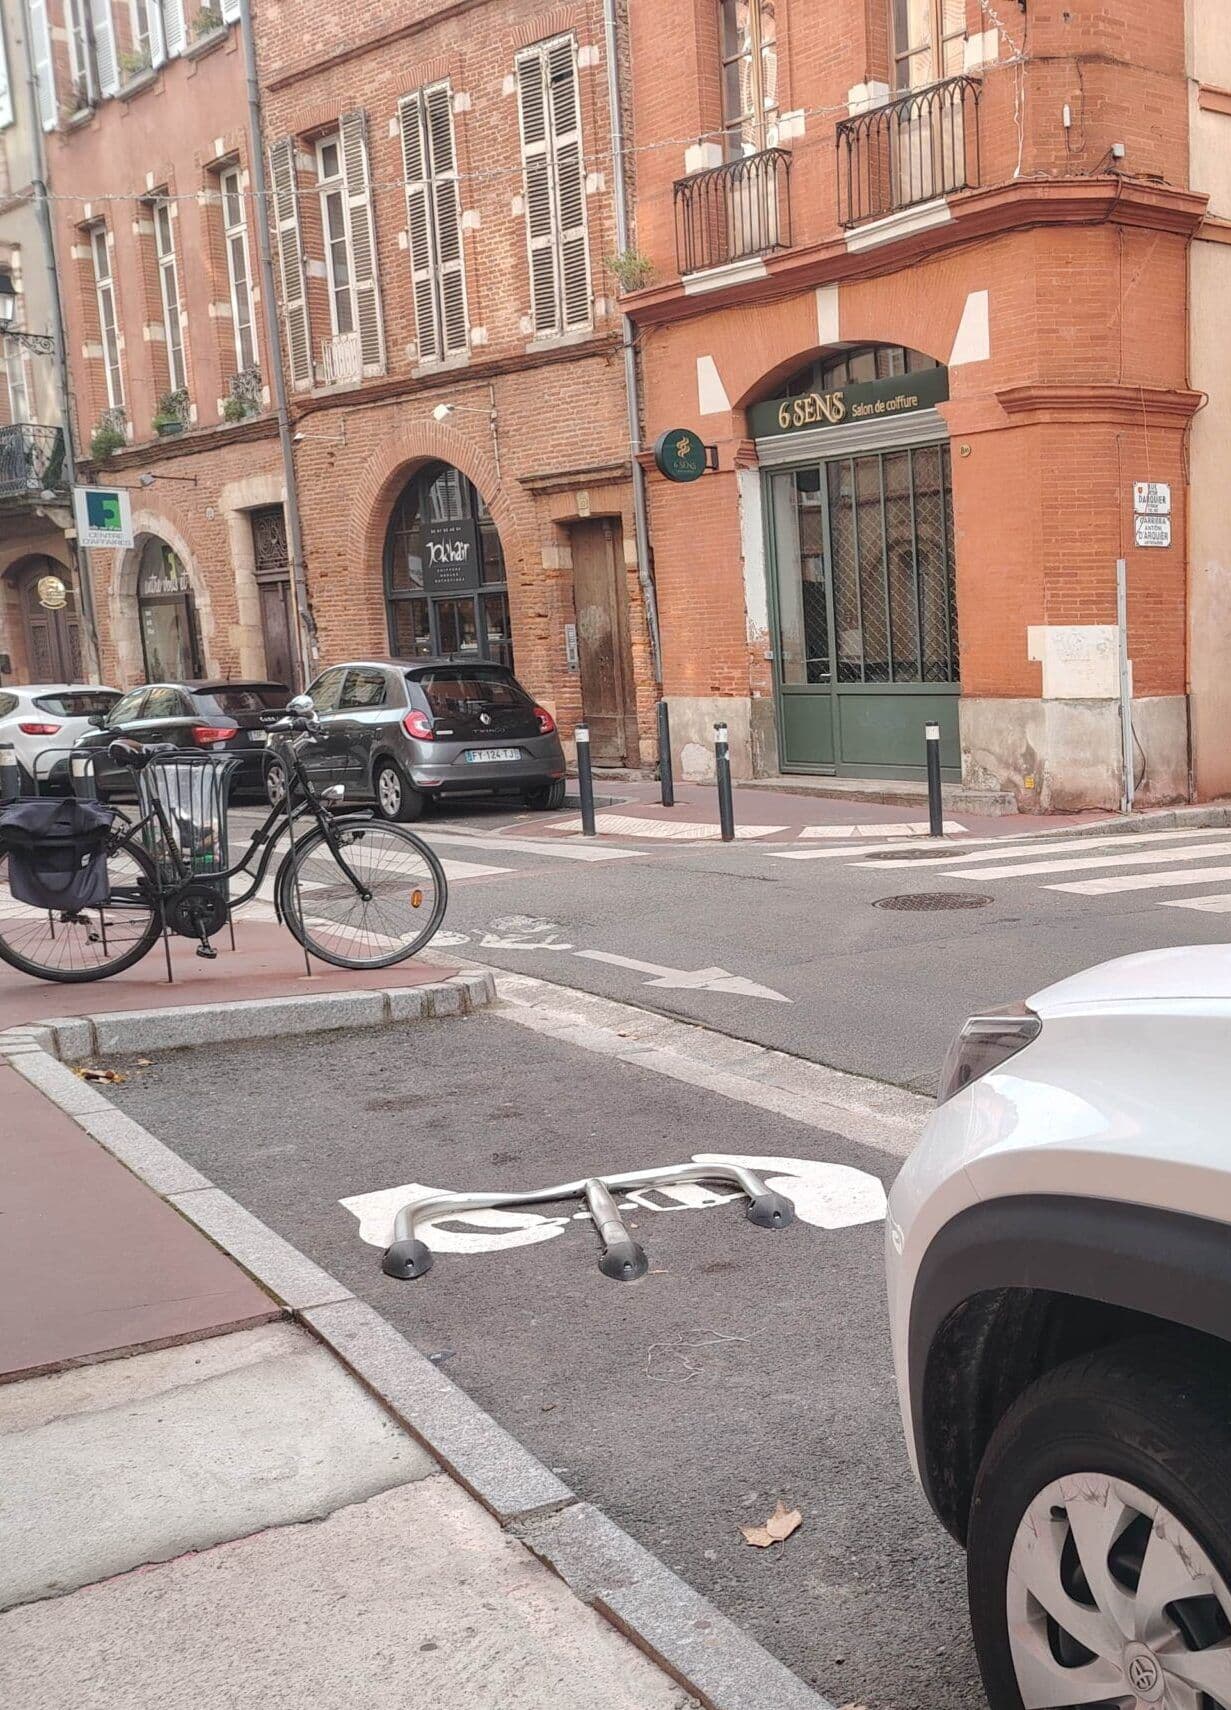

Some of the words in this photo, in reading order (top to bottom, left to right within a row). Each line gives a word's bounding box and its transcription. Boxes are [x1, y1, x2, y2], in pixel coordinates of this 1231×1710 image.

[778, 401, 791, 428] 6
[792, 392, 846, 427] SENS
[852, 403, 874, 418] Salon
[874, 400, 886, 414] de
[886, 394, 918, 412] coiffure
